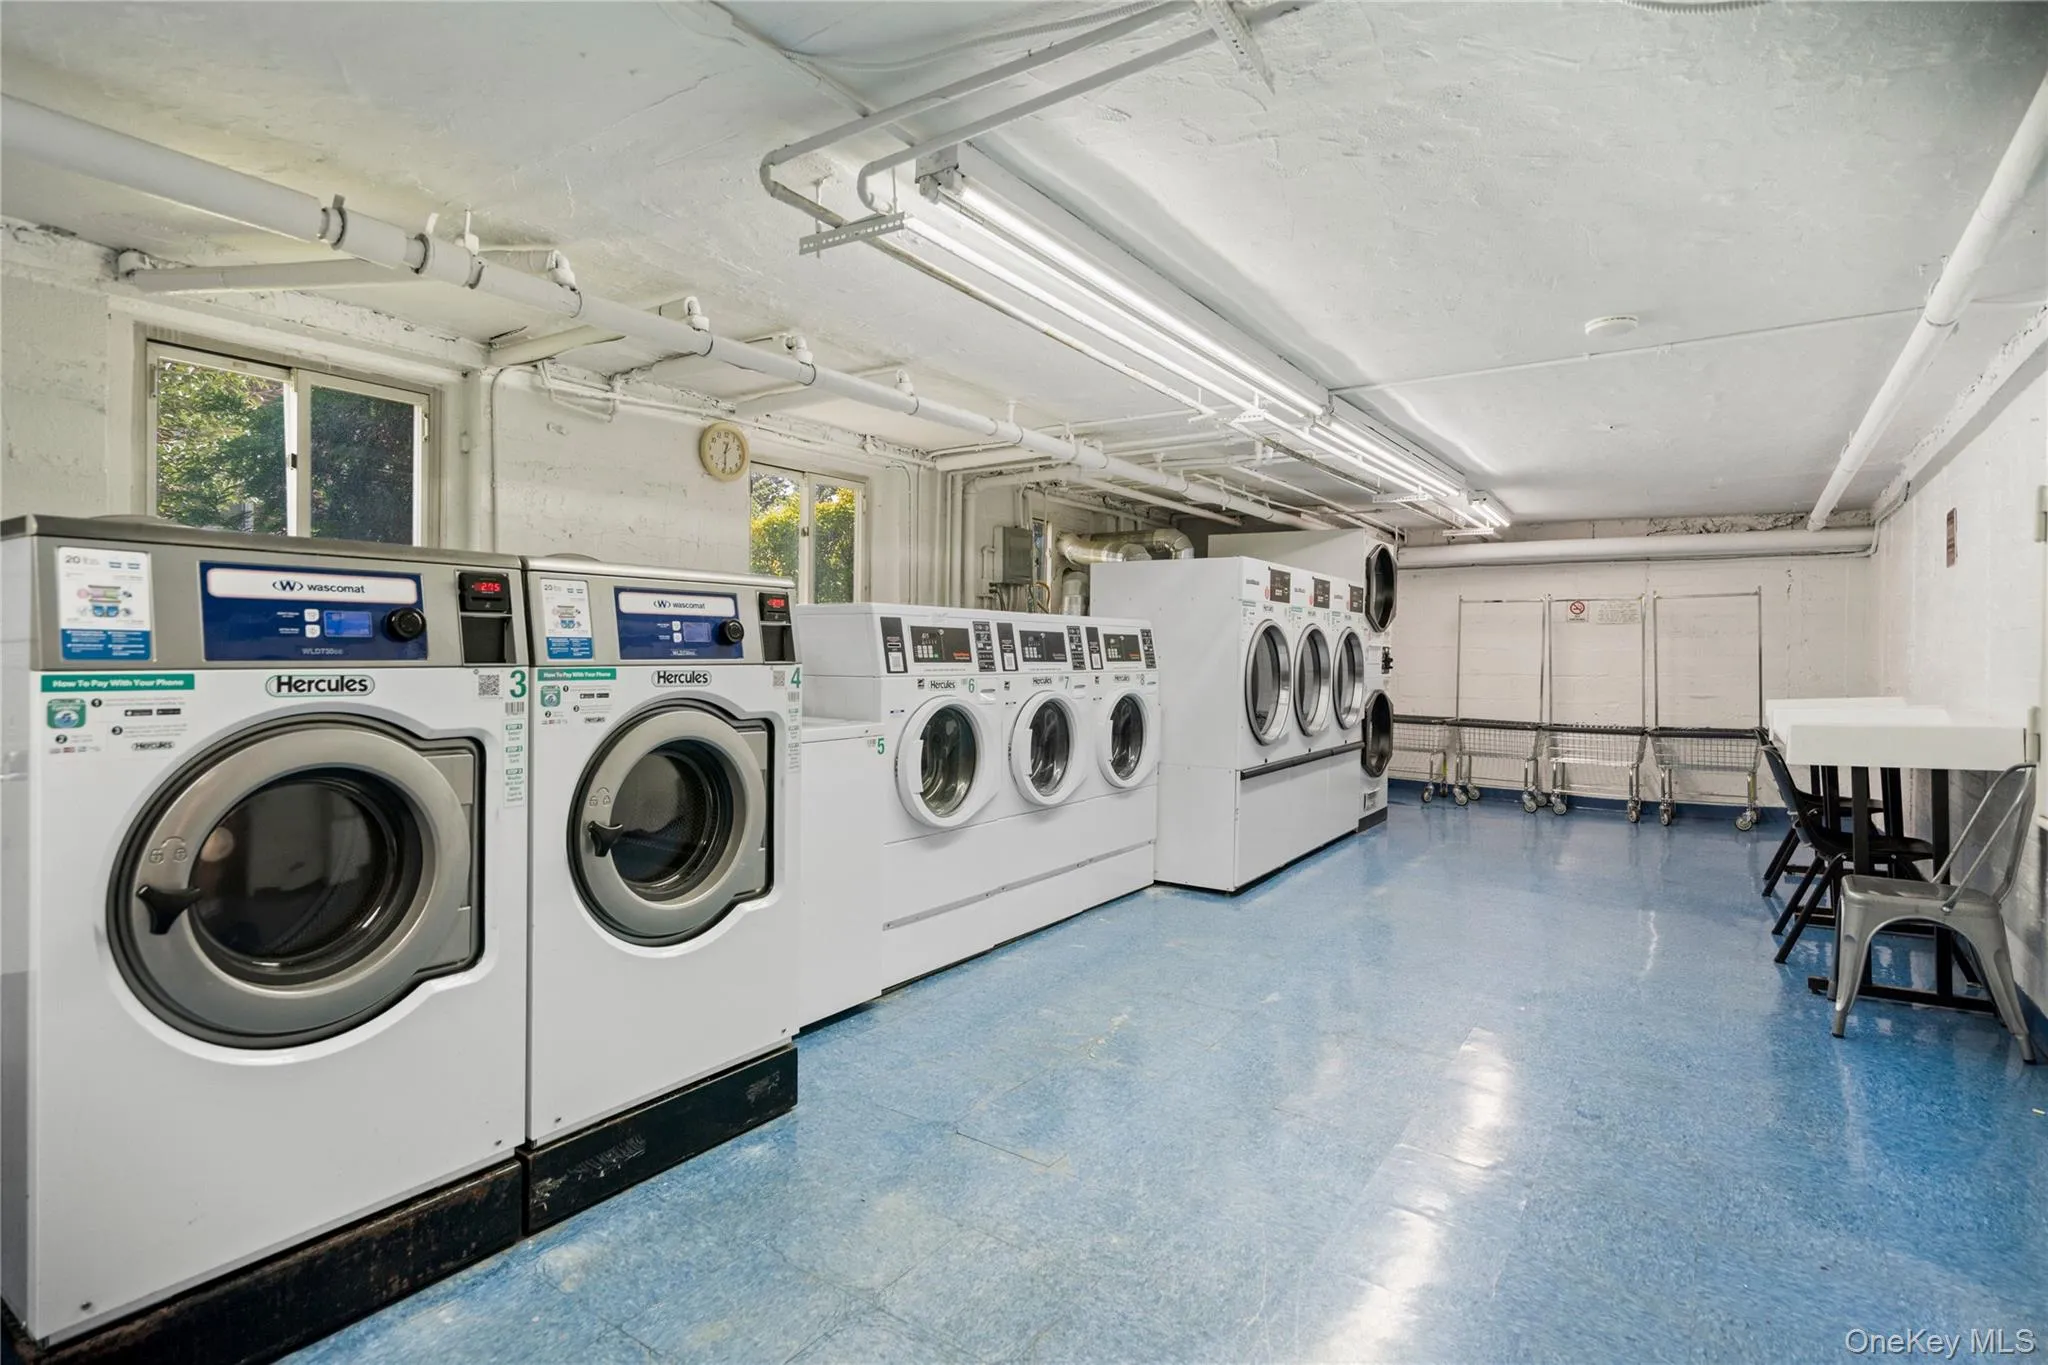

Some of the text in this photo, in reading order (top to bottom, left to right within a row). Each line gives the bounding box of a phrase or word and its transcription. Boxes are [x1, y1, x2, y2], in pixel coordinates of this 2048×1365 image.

[65, 555, 80, 564] 20
[307, 583, 365, 594] wascomat
[672, 601, 705, 610] wascomat
[52, 678, 184, 689] How To Pay With Your Phone
[277, 675, 368, 692] Hercules
[509, 669, 527, 698] 3
[656, 671, 709, 684] Hercules
[790, 667, 802, 688] 4
[930, 680, 956, 690] Hercules
[968, 678, 975, 693] 6
[877, 737, 885, 755] 5
